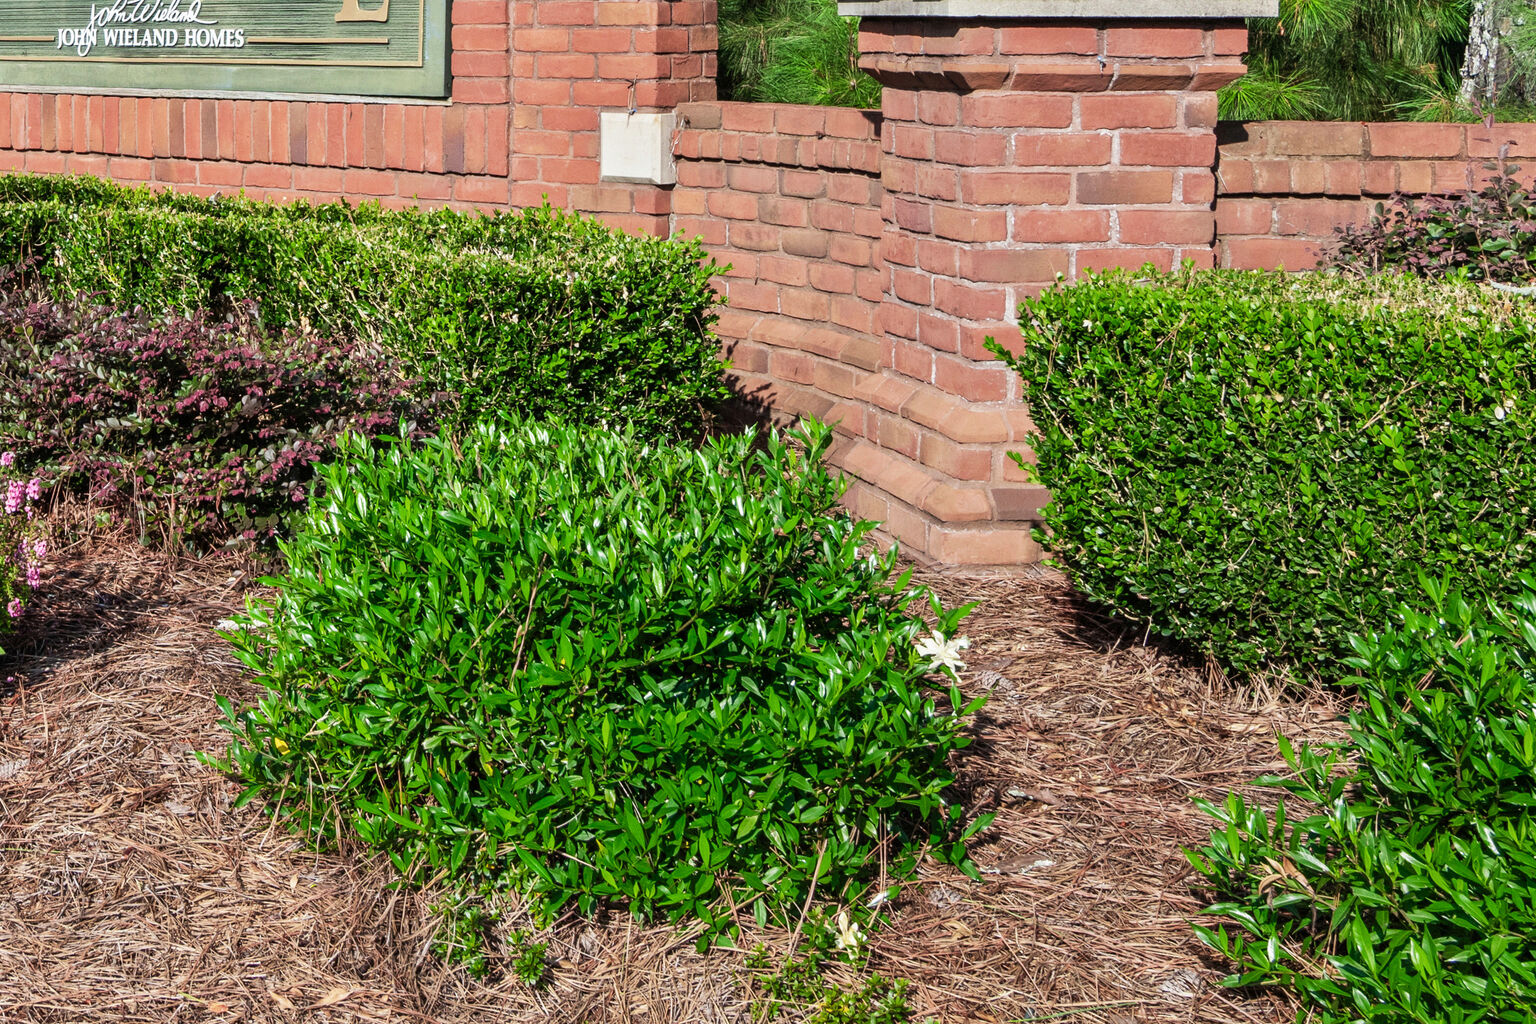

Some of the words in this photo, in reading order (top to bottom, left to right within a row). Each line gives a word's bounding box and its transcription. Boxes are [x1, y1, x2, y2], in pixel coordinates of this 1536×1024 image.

[56, 28, 97, 49] JOHN
[103, 28, 178, 47] WIELAND
[184, 28, 245, 48] HOMES
